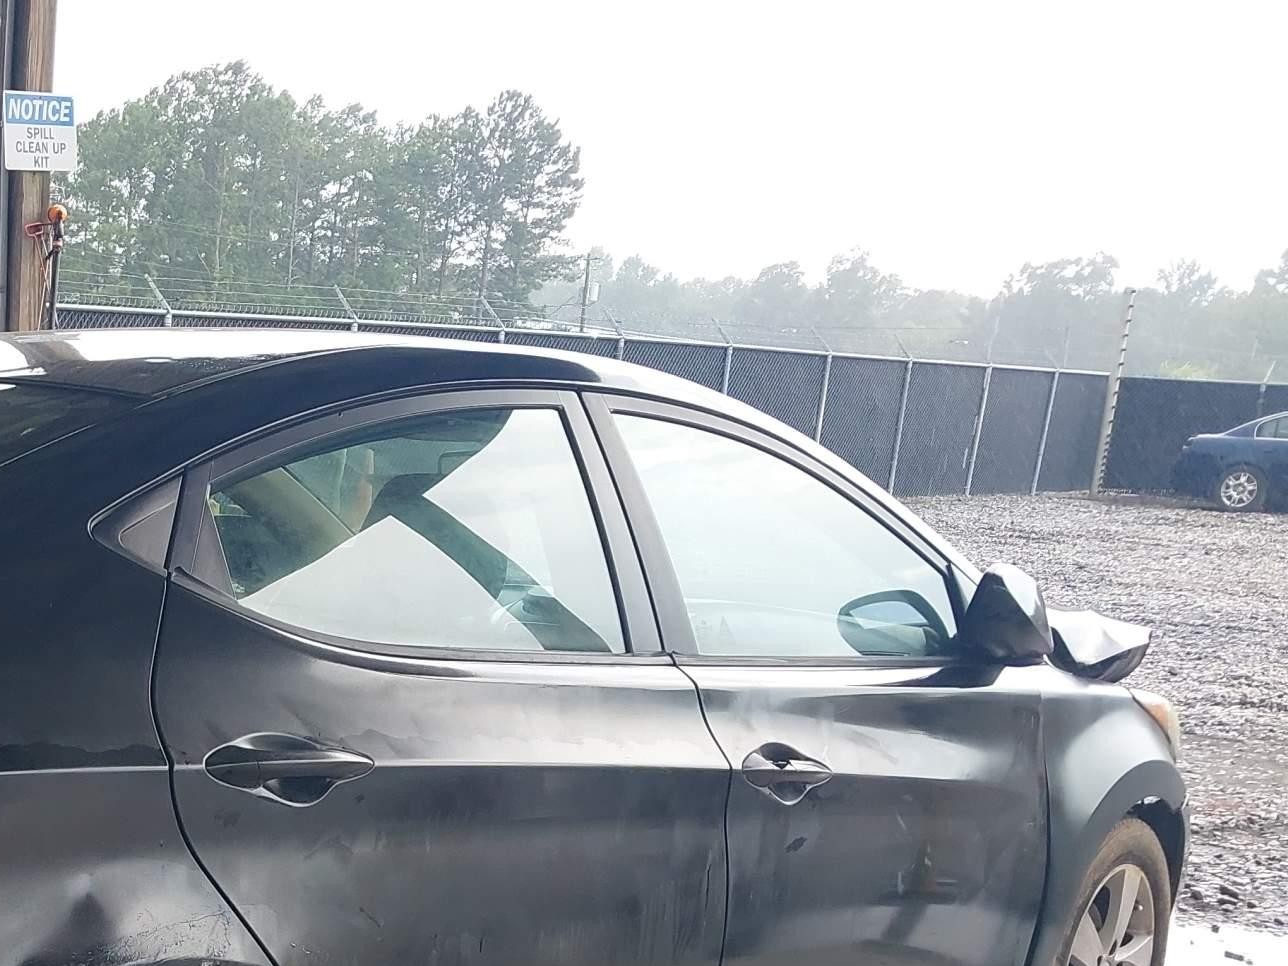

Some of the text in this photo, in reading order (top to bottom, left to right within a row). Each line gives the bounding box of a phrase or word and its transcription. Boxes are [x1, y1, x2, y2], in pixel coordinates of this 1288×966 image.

[8, 98, 72, 122] NOTICE
[26, 127, 55, 140] SPILL
[15, 141, 66, 155] CLEAN UP
[33, 156, 50, 168] KIT
